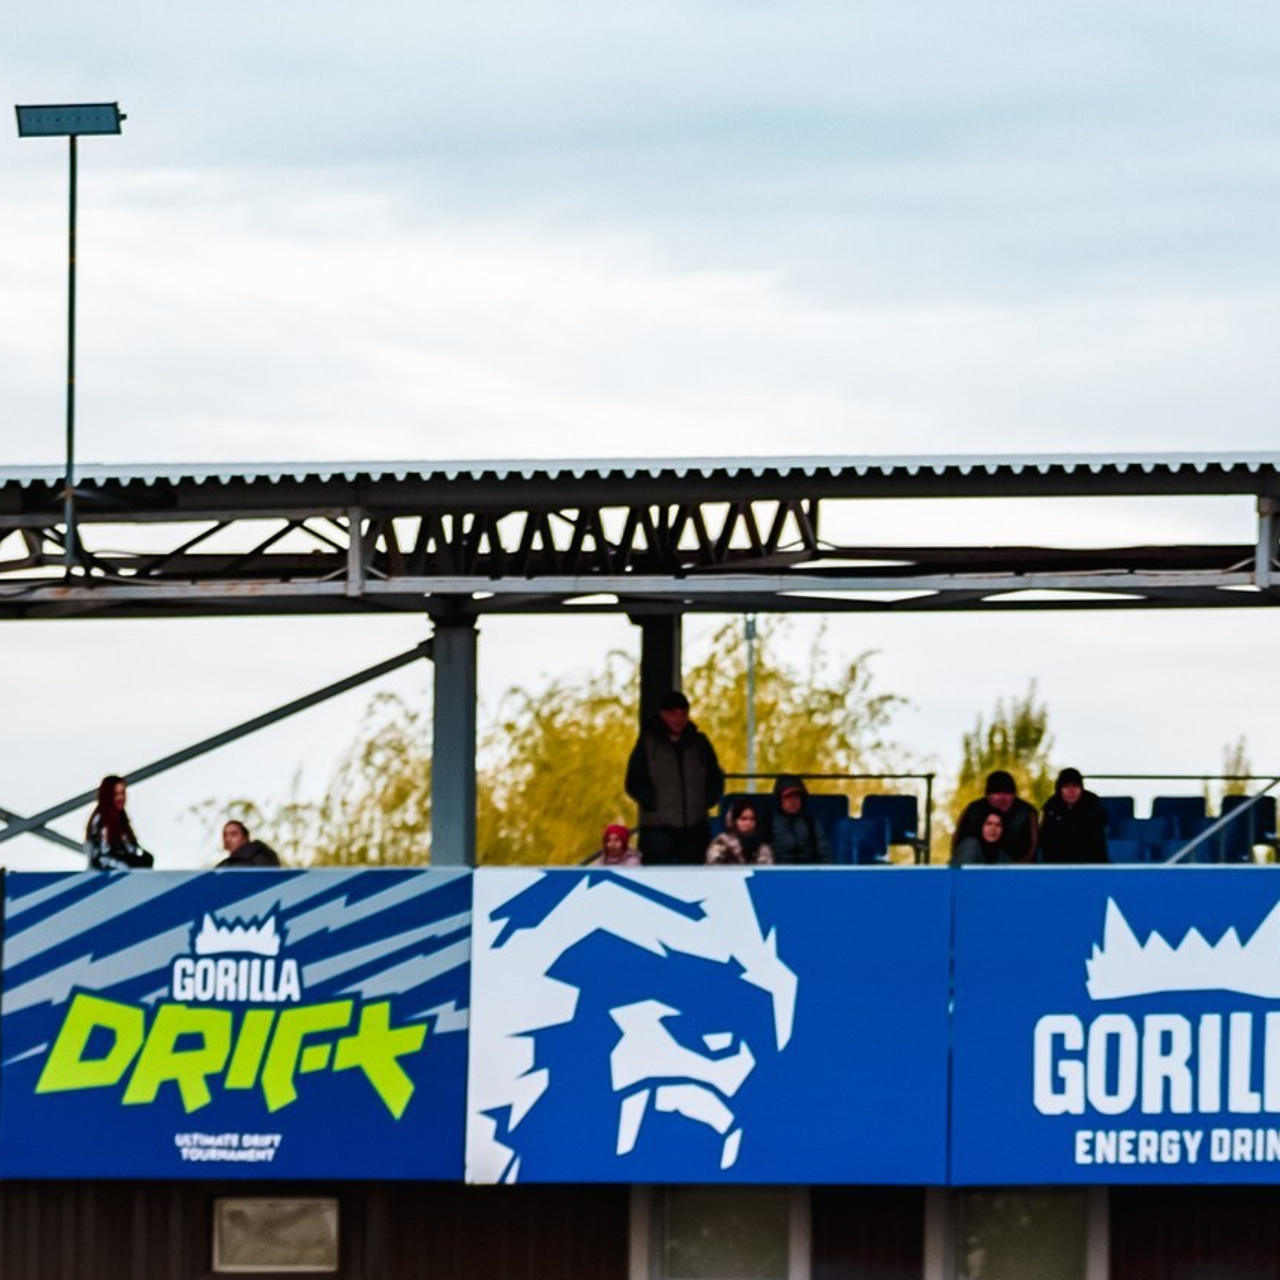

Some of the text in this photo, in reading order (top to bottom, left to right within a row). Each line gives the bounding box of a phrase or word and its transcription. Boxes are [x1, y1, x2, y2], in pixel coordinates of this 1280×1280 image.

[172, 958, 301, 1002] GORILLA
[35, 994, 428, 1120] DRIFT
[1075, 1130, 1203, 1164] ENERGY
